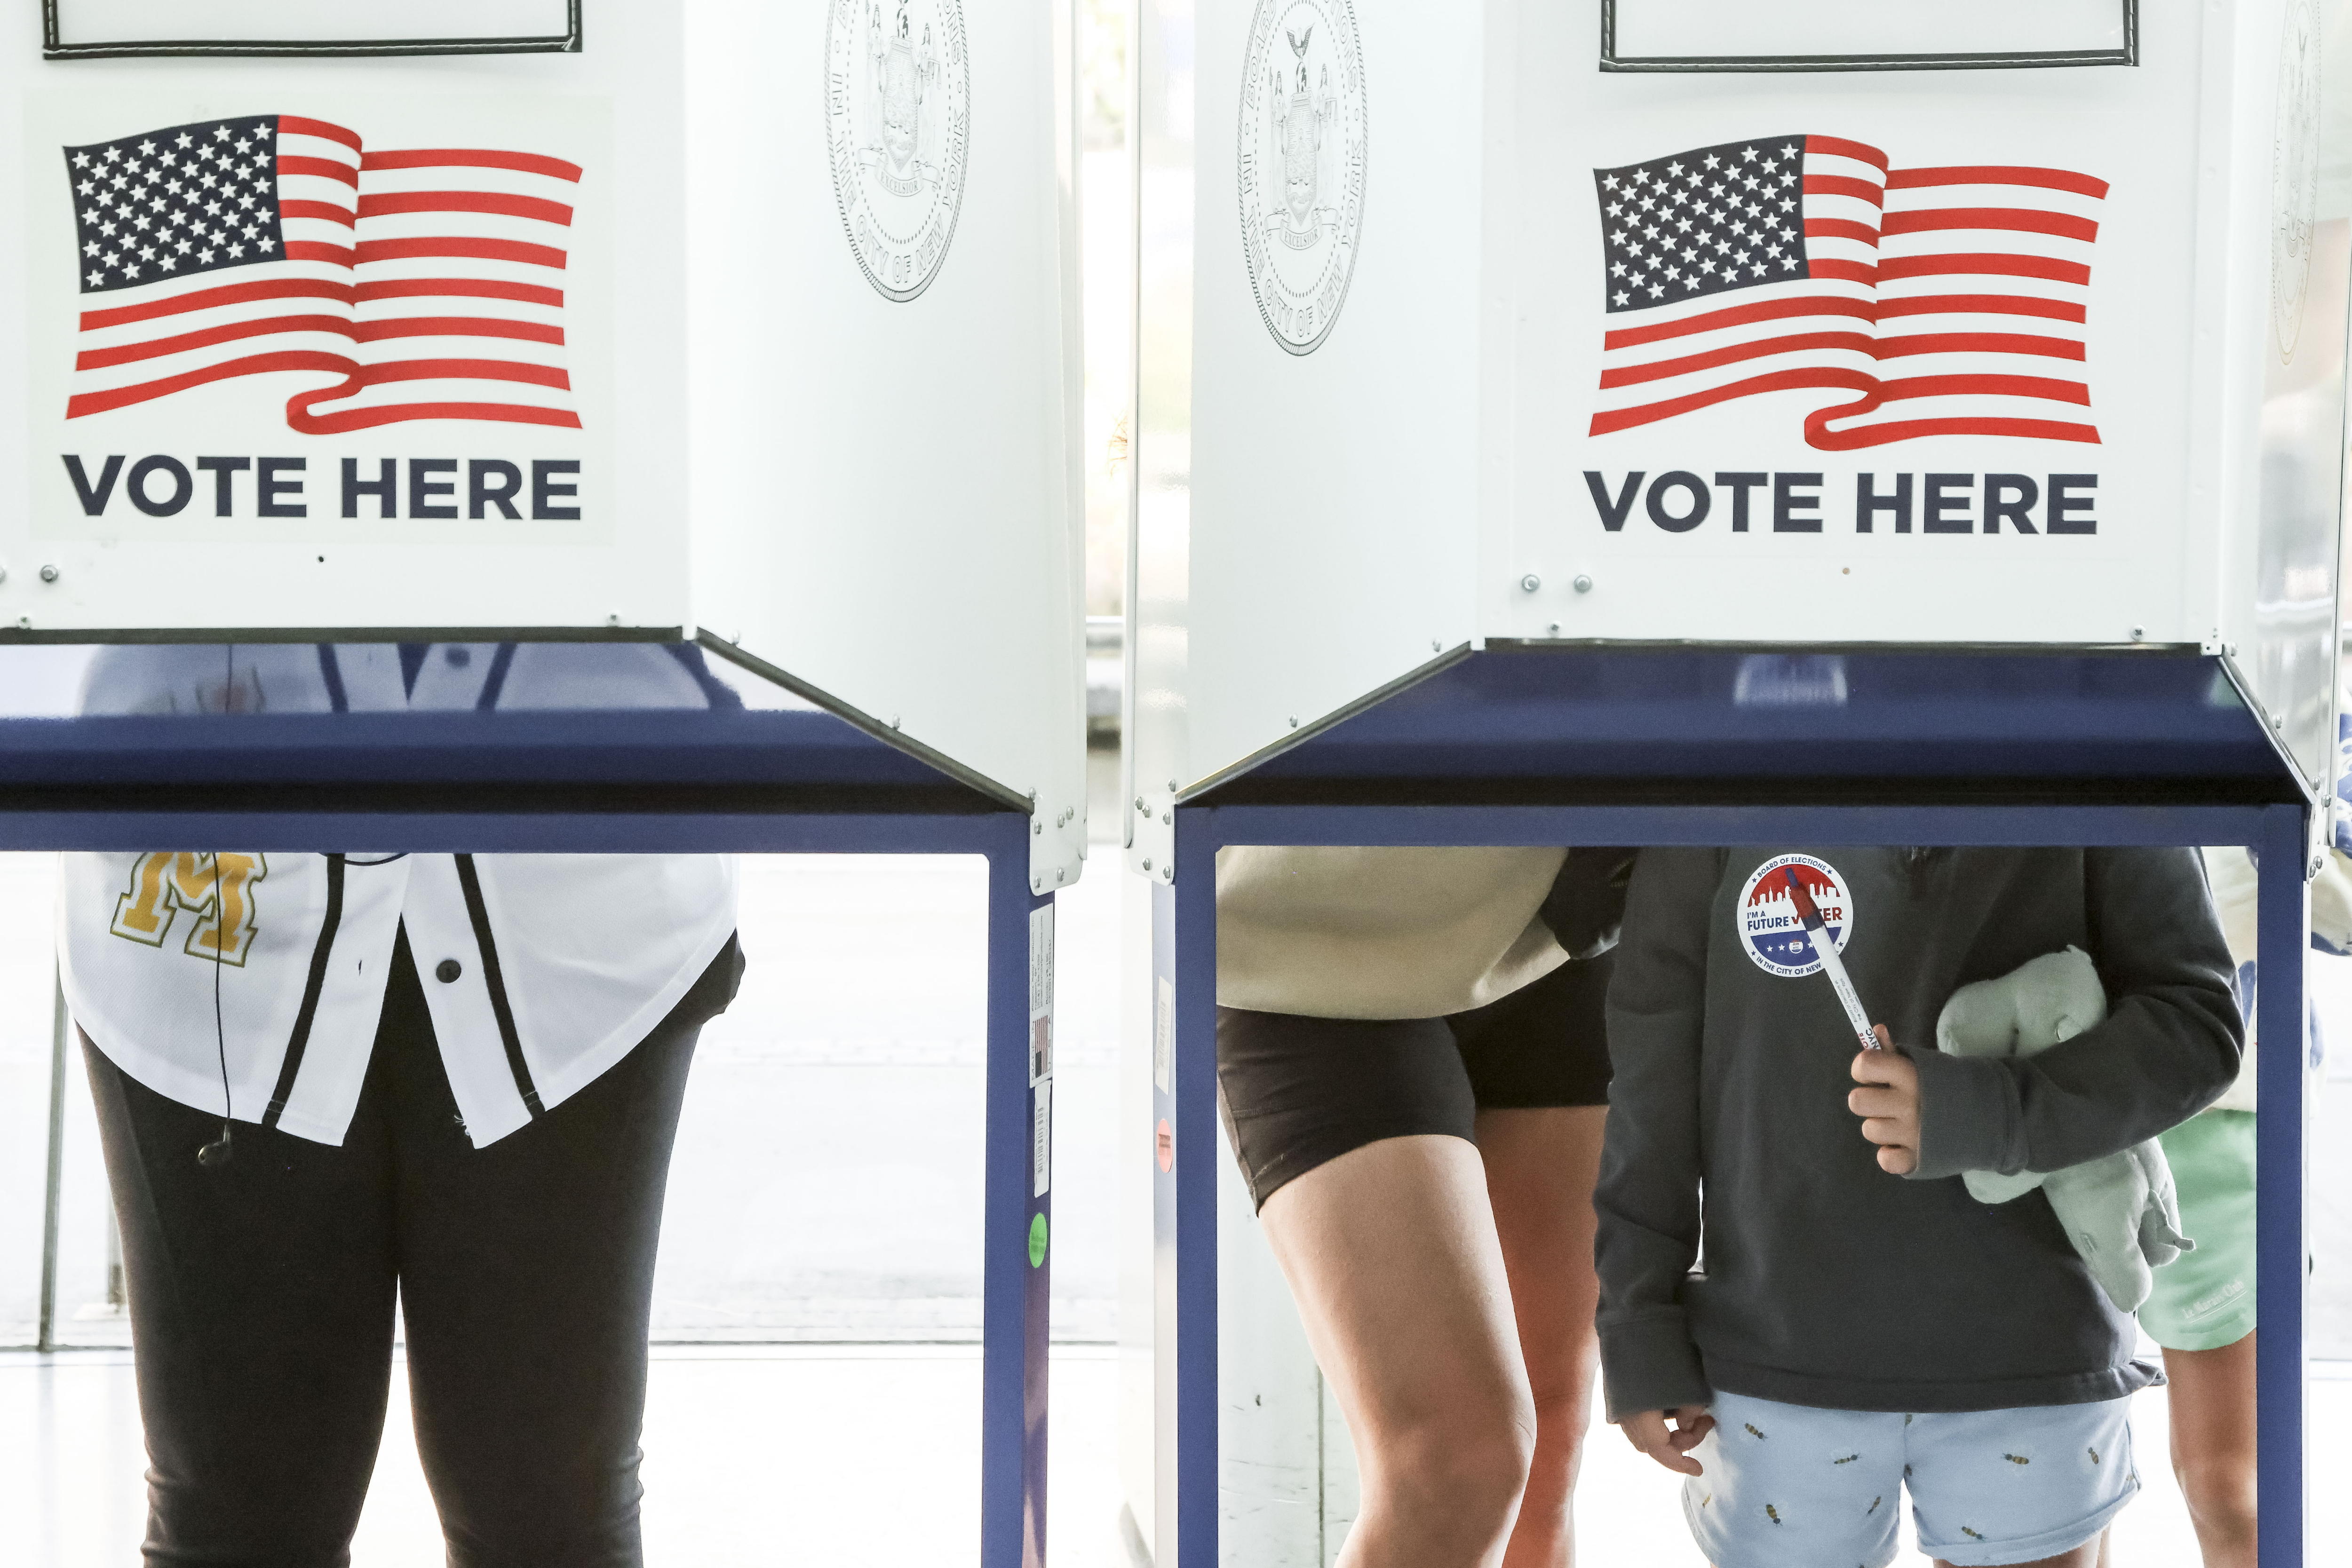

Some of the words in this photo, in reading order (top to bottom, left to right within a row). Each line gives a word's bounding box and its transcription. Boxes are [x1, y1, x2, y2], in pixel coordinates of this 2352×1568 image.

[832, 73, 842, 115] IN
[836, 131, 857, 212] THE
[881, 171, 918, 194] EXCELSIOR
[942, 108, 964, 211] YORK
[1243, 154, 1252, 194] IN
[1341, 139, 1361, 248] YORK
[856, 214, 889, 275] CITY
[916, 213, 944, 276] NEW
[1247, 205, 1264, 280] THE
[1285, 228, 1319, 247] EXCELSIOR
[892, 255, 911, 283] OF
[1317, 254, 1343, 324] NEW
[1265, 279, 1293, 333] CITY
[1296, 306, 1313, 337] OF
[61, 454, 308, 518] VOTE
[340, 458, 581, 521] HERE
[1583, 470, 1824, 533] VOTE
[1856, 472, 2098, 535] HERE
[1757, 861, 1778, 878] BOARD
[1791, 857, 1827, 871] ELECTIONS
[110, 852, 267, 968] M
[1748, 916, 1789, 931] FUTURE
[1764, 962, 1774, 971] THE
[1776, 966, 1792, 975] CITY
[1806, 962, 1821, 972] NEW
[1866, 1028, 1880, 1049] NYC
